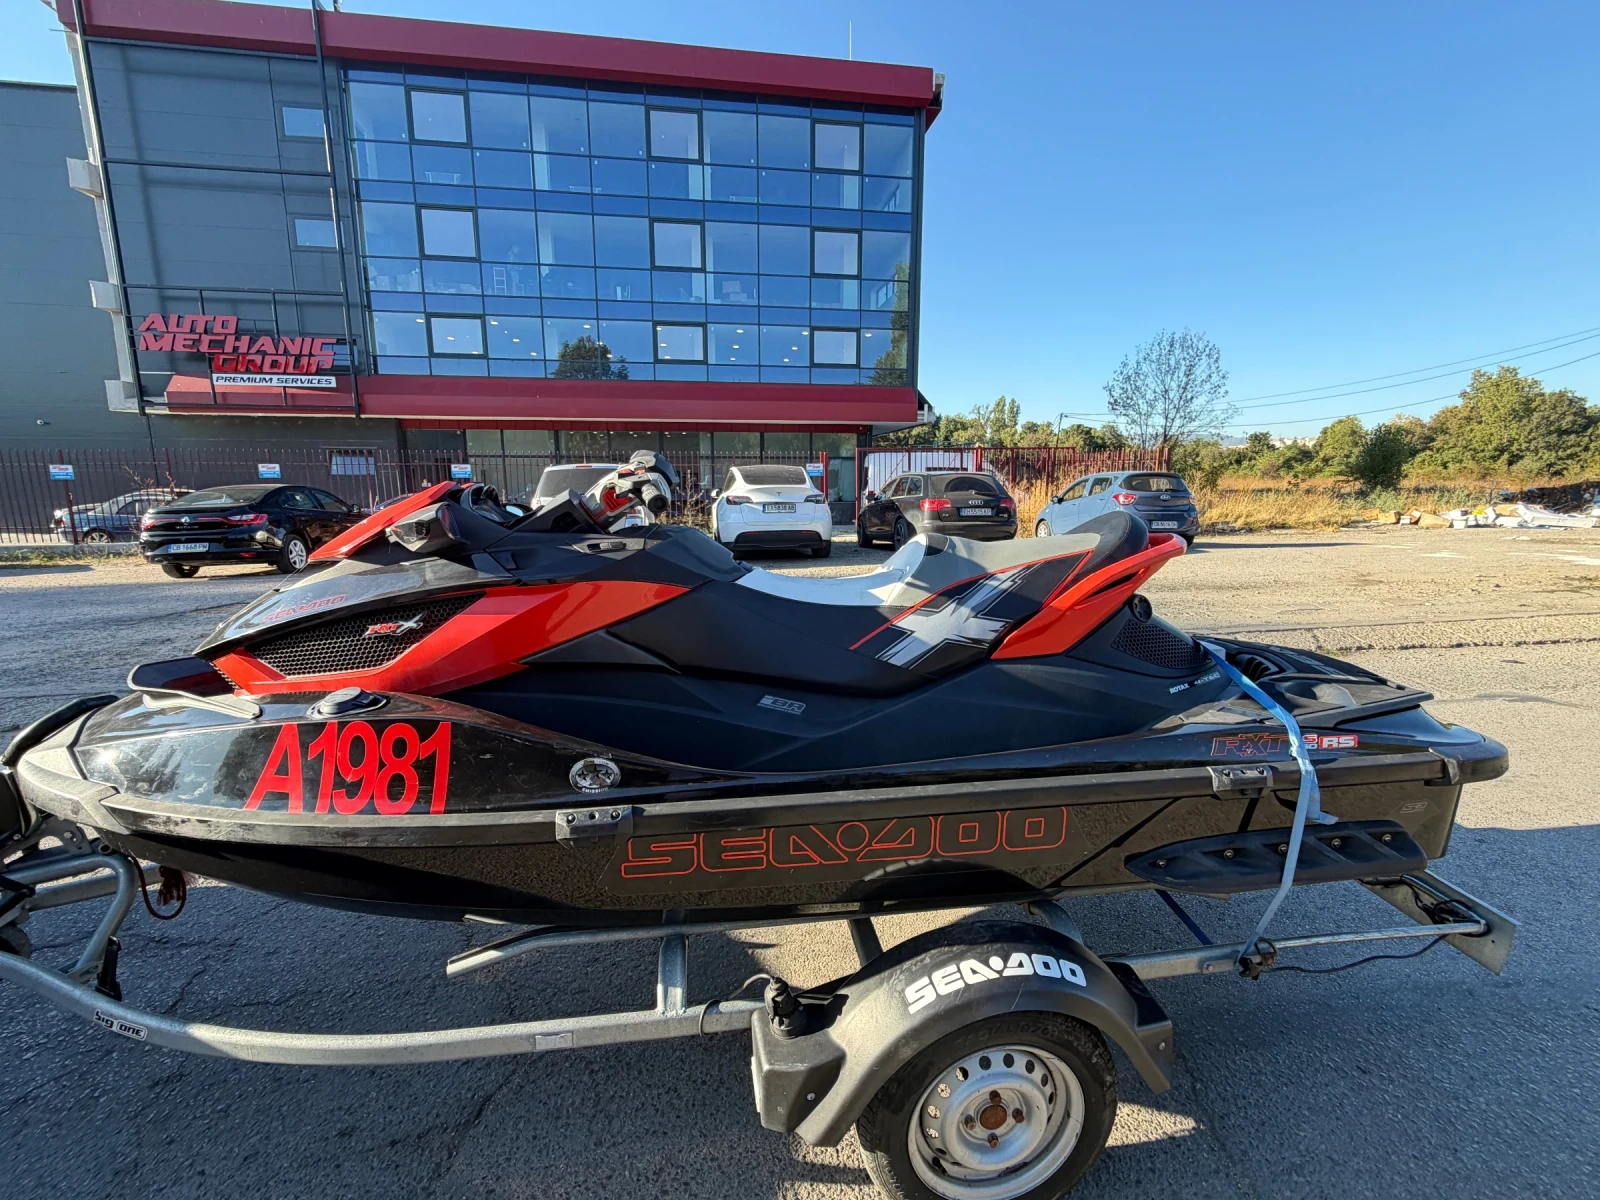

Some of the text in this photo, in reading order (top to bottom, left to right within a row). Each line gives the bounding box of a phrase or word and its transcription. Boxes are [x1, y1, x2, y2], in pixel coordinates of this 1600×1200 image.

[138, 313, 239, 334] AUTO
[139, 333, 337, 355] MECHANIC
[212, 354, 334, 373] GROUP
[215, 375, 333, 385] PREMIUM SERVICES
[1169, 682, 1190, 694] ROTAX
[1322, 736, 1355, 749] RS
[243, 721, 451, 815] A1981
